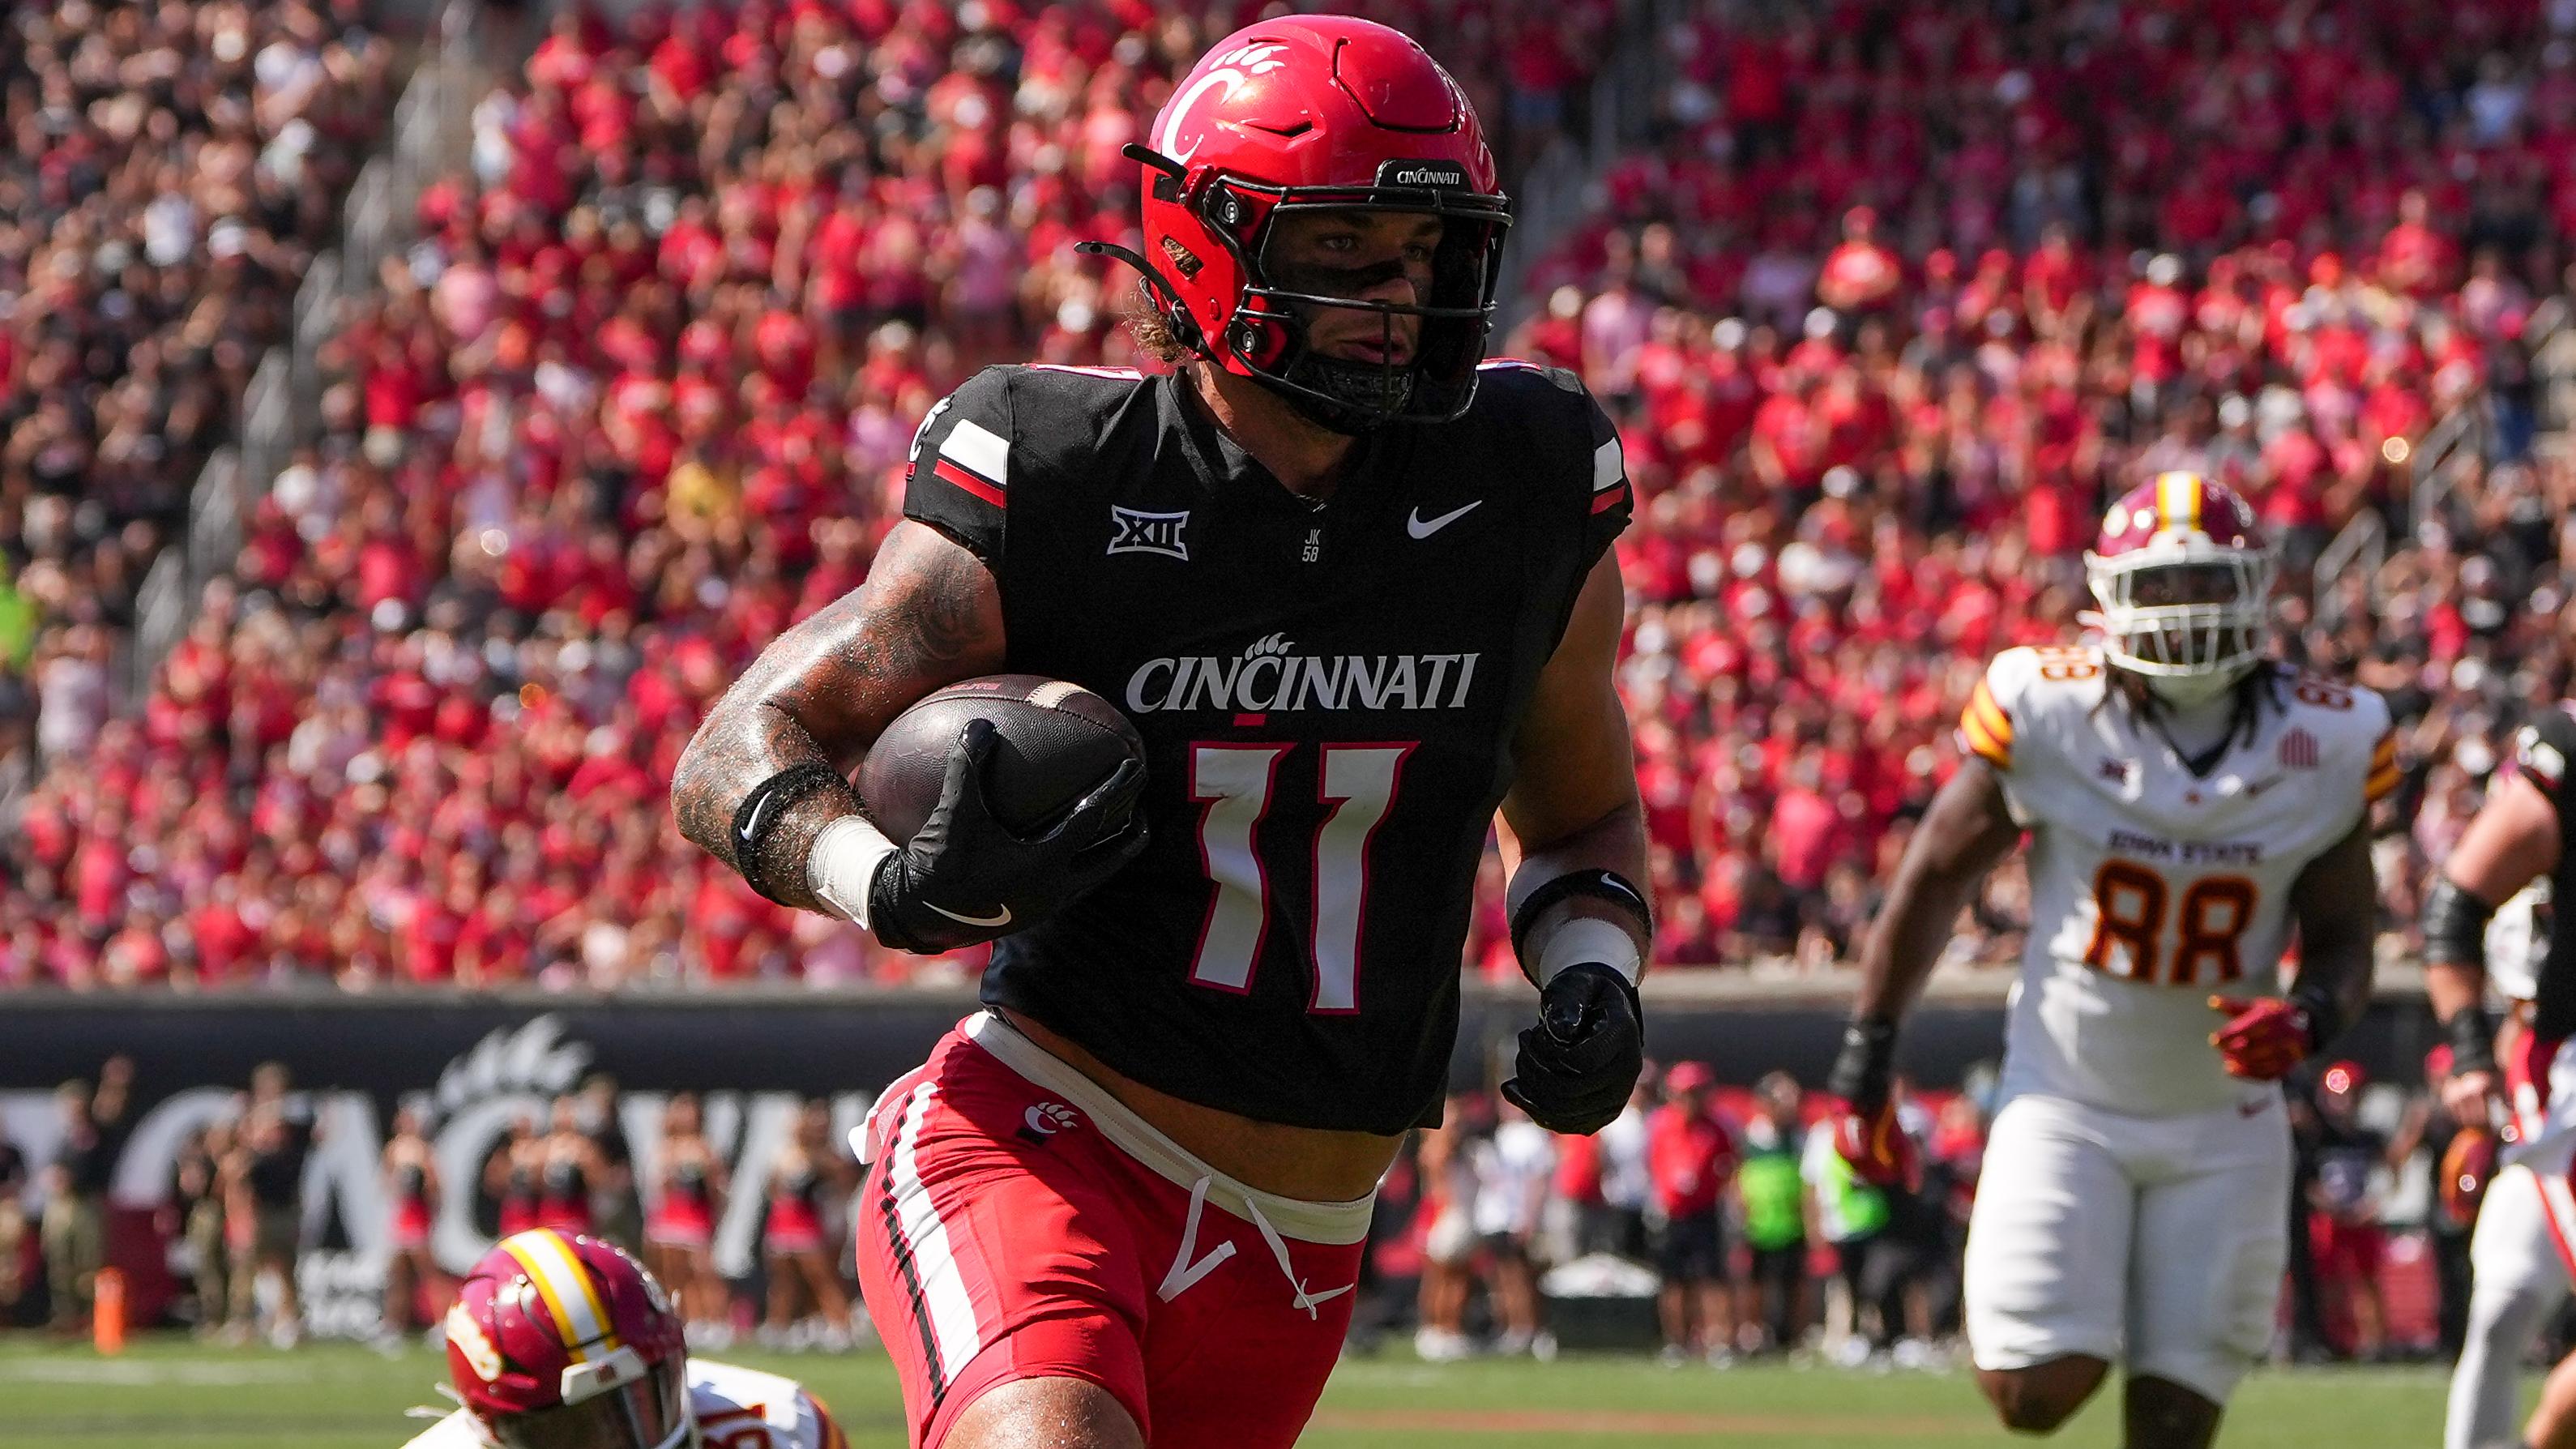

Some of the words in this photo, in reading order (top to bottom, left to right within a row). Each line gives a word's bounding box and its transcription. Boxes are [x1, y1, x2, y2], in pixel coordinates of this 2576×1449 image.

[1396, 167, 1460, 185] CINCINNATI
[1301, 545, 1319, 562] 58
[1305, 529, 1321, 545] JK
[1126, 644, 1480, 714] CINCINNATI
[1187, 740, 1421, 1015] 11
[2083, 859, 2260, 986] 88
